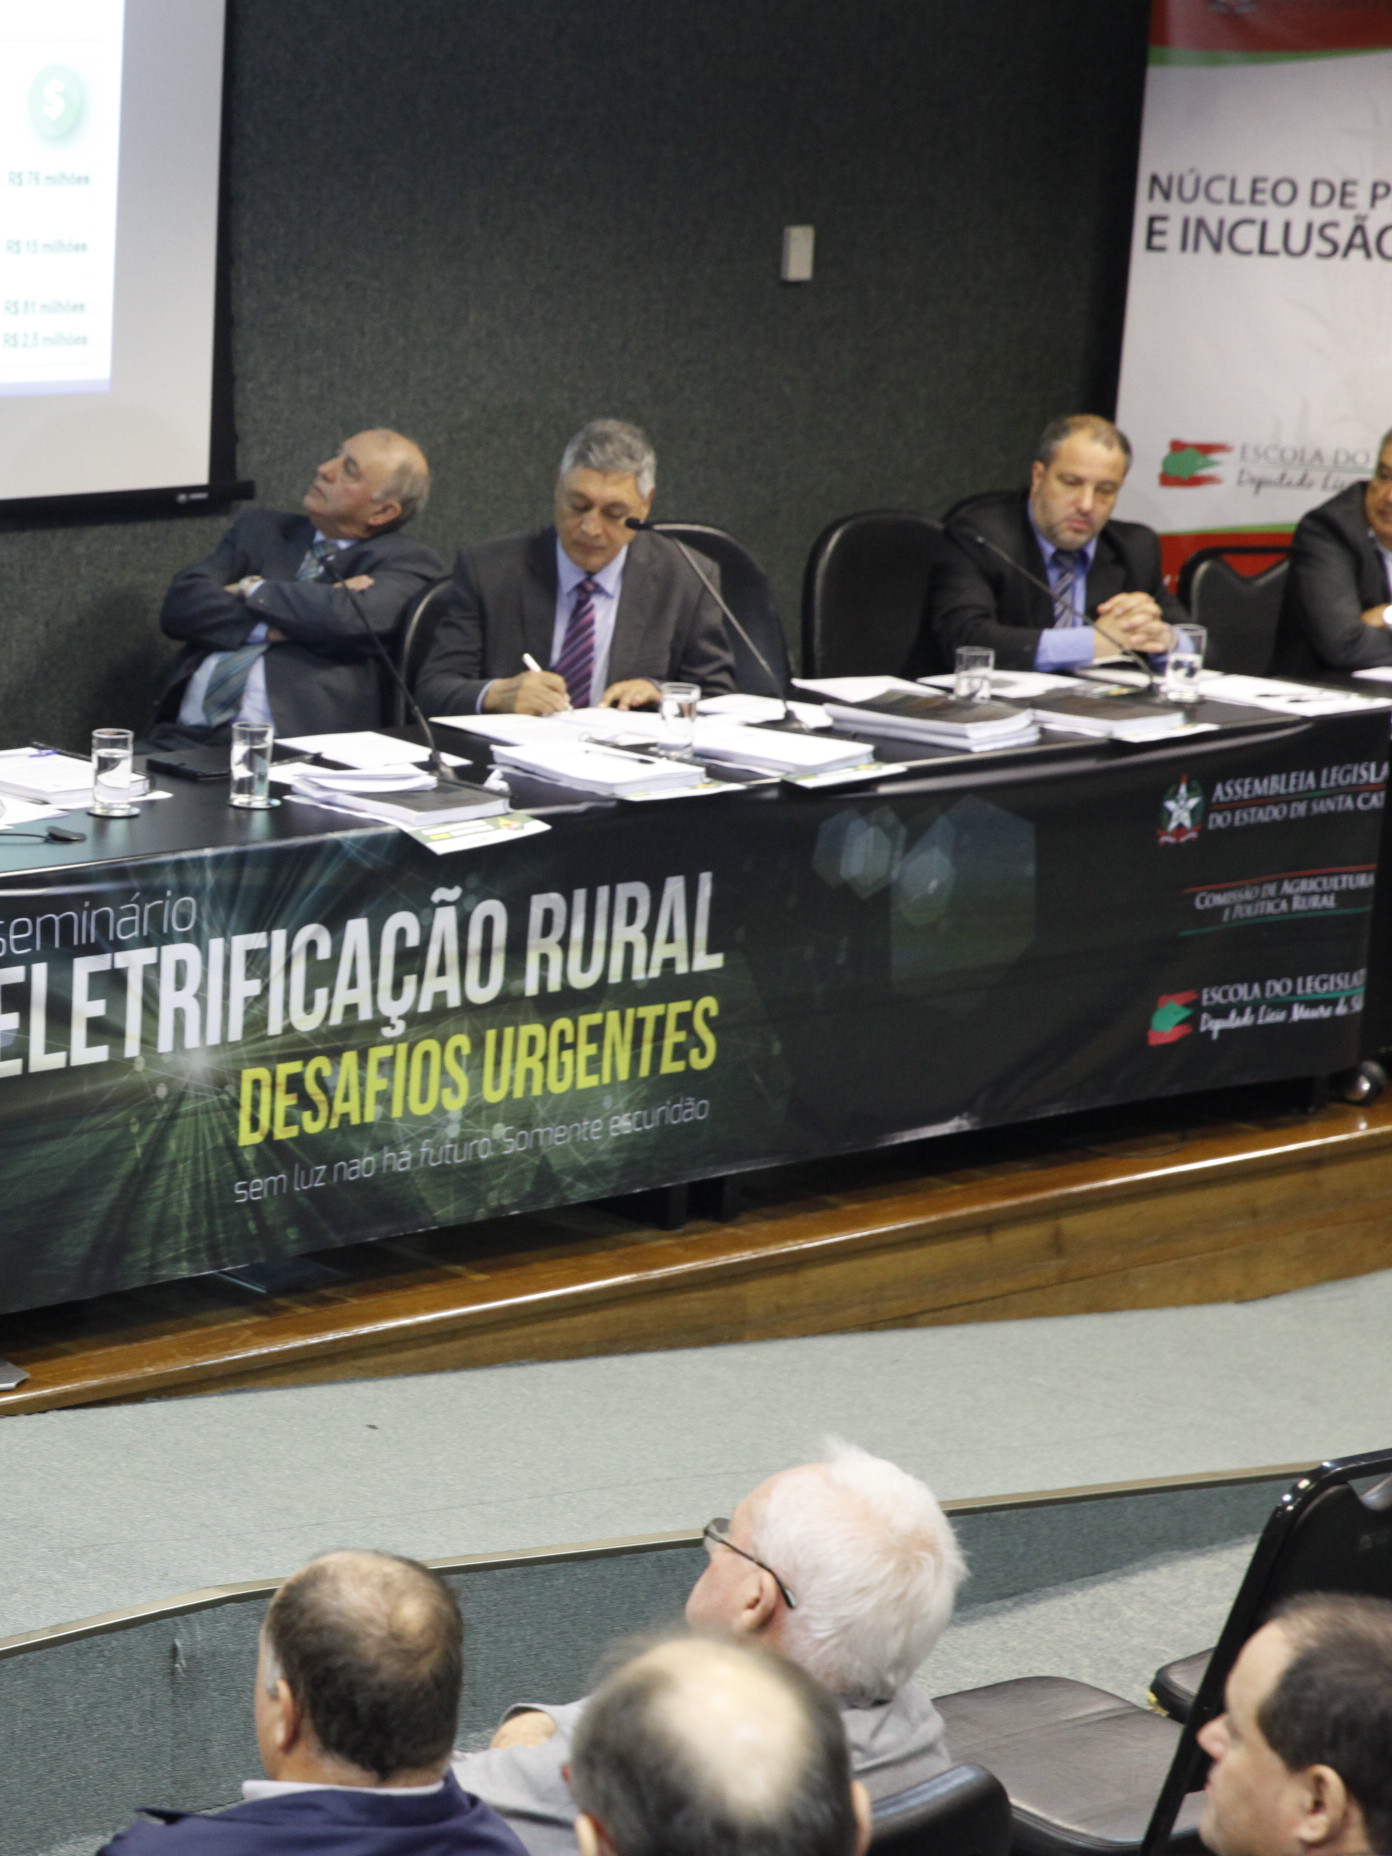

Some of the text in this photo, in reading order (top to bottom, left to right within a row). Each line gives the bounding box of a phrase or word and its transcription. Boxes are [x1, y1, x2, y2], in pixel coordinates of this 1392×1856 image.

[1148, 167, 1298, 208] NÚCLEO
[1310, 178, 1359, 211] DE
[1145, 215, 1170, 253] E
[1240, 442, 1371, 467] ESCOLA DO
[1211, 768, 1317, 803] ASSEMBLEIA
[1207, 810, 1233, 831] DO
[1234, 802, 1289, 828] ESTADO
[1289, 798, 1308, 820] DE
[1310, 793, 1355, 817] SANTA
[524, 871, 725, 998] RURAL
[1201, 982, 1262, 1006] ESCOLA
[1264, 977, 1294, 999] DO
[237, 995, 720, 1147] DESAFIOS URGENTES
[234, 1173, 288, 1203] sem
[292, 1162, 327, 1191] luz
[501, 1118, 604, 1154] Somente
[608, 1096, 710, 1137] escuridão
